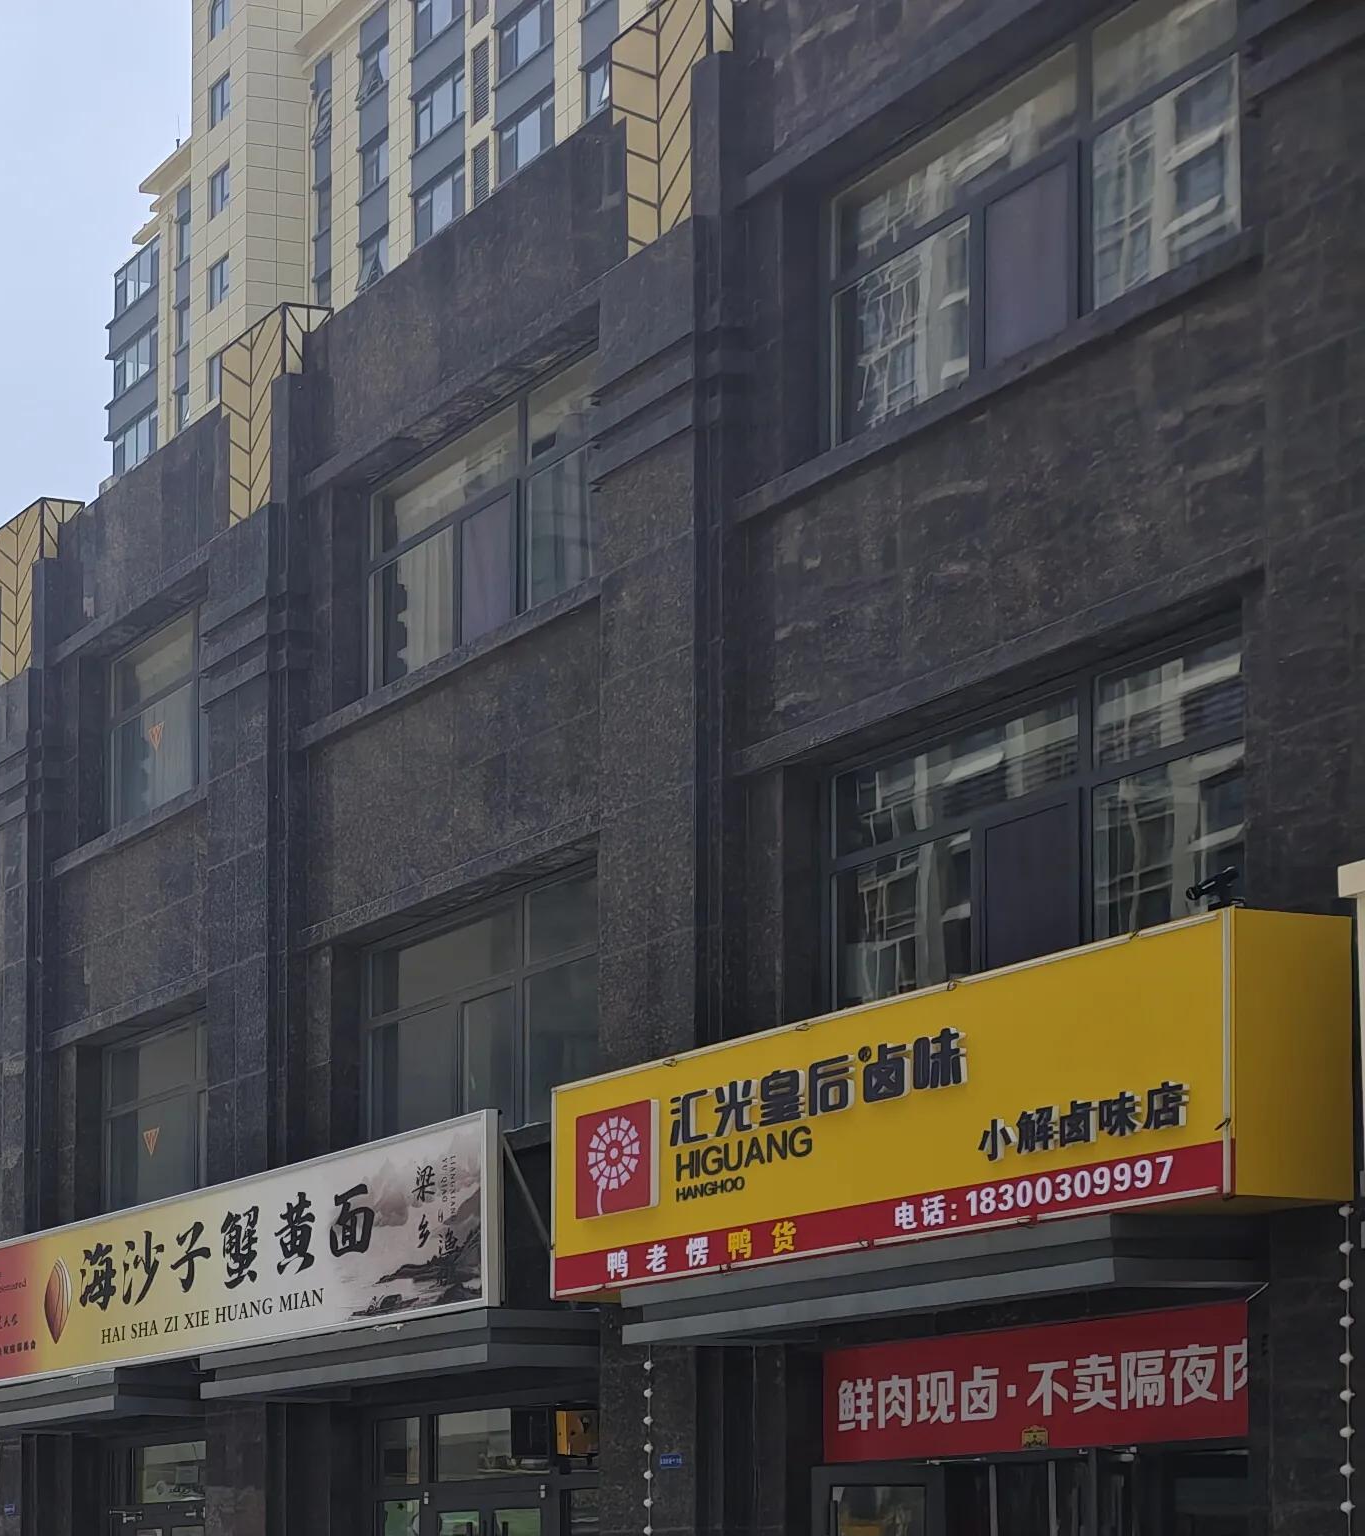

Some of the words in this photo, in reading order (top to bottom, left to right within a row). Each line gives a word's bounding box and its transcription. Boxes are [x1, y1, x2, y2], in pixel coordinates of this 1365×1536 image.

[675, 1126, 813, 1182] HIGUANG
[977, 1081, 1191, 1162] 小解卤味店
[79, 1183, 376, 1311] 海沙子蟹黄面
[101, 1324, 126, 1345] HAI
[131, 1318, 158, 1339] SHA
[164, 1315, 179, 1333] ZI
[184, 1309, 210, 1330] XIE
[215, 1297, 273, 1324] HUANG
[279, 1287, 324, 1313] MIAN
